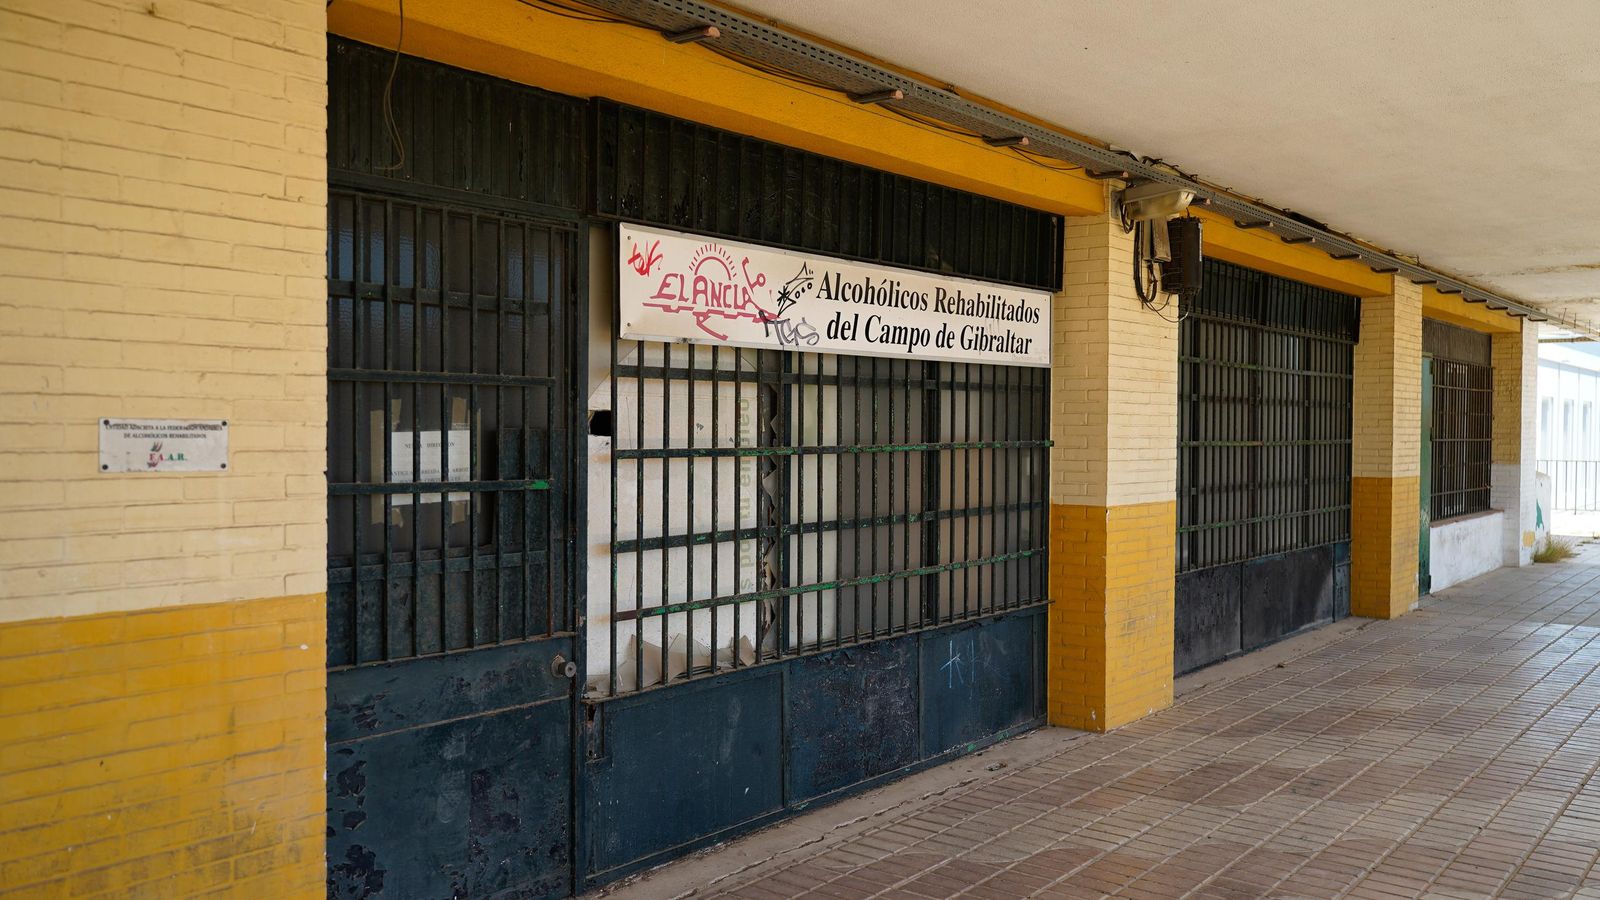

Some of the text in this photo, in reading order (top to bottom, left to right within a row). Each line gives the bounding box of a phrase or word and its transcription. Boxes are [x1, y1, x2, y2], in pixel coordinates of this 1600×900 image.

[816, 270, 1040, 324] Alcohólicos Rehabilitados
[827, 311, 1033, 355] del Campo de Gibraltar
